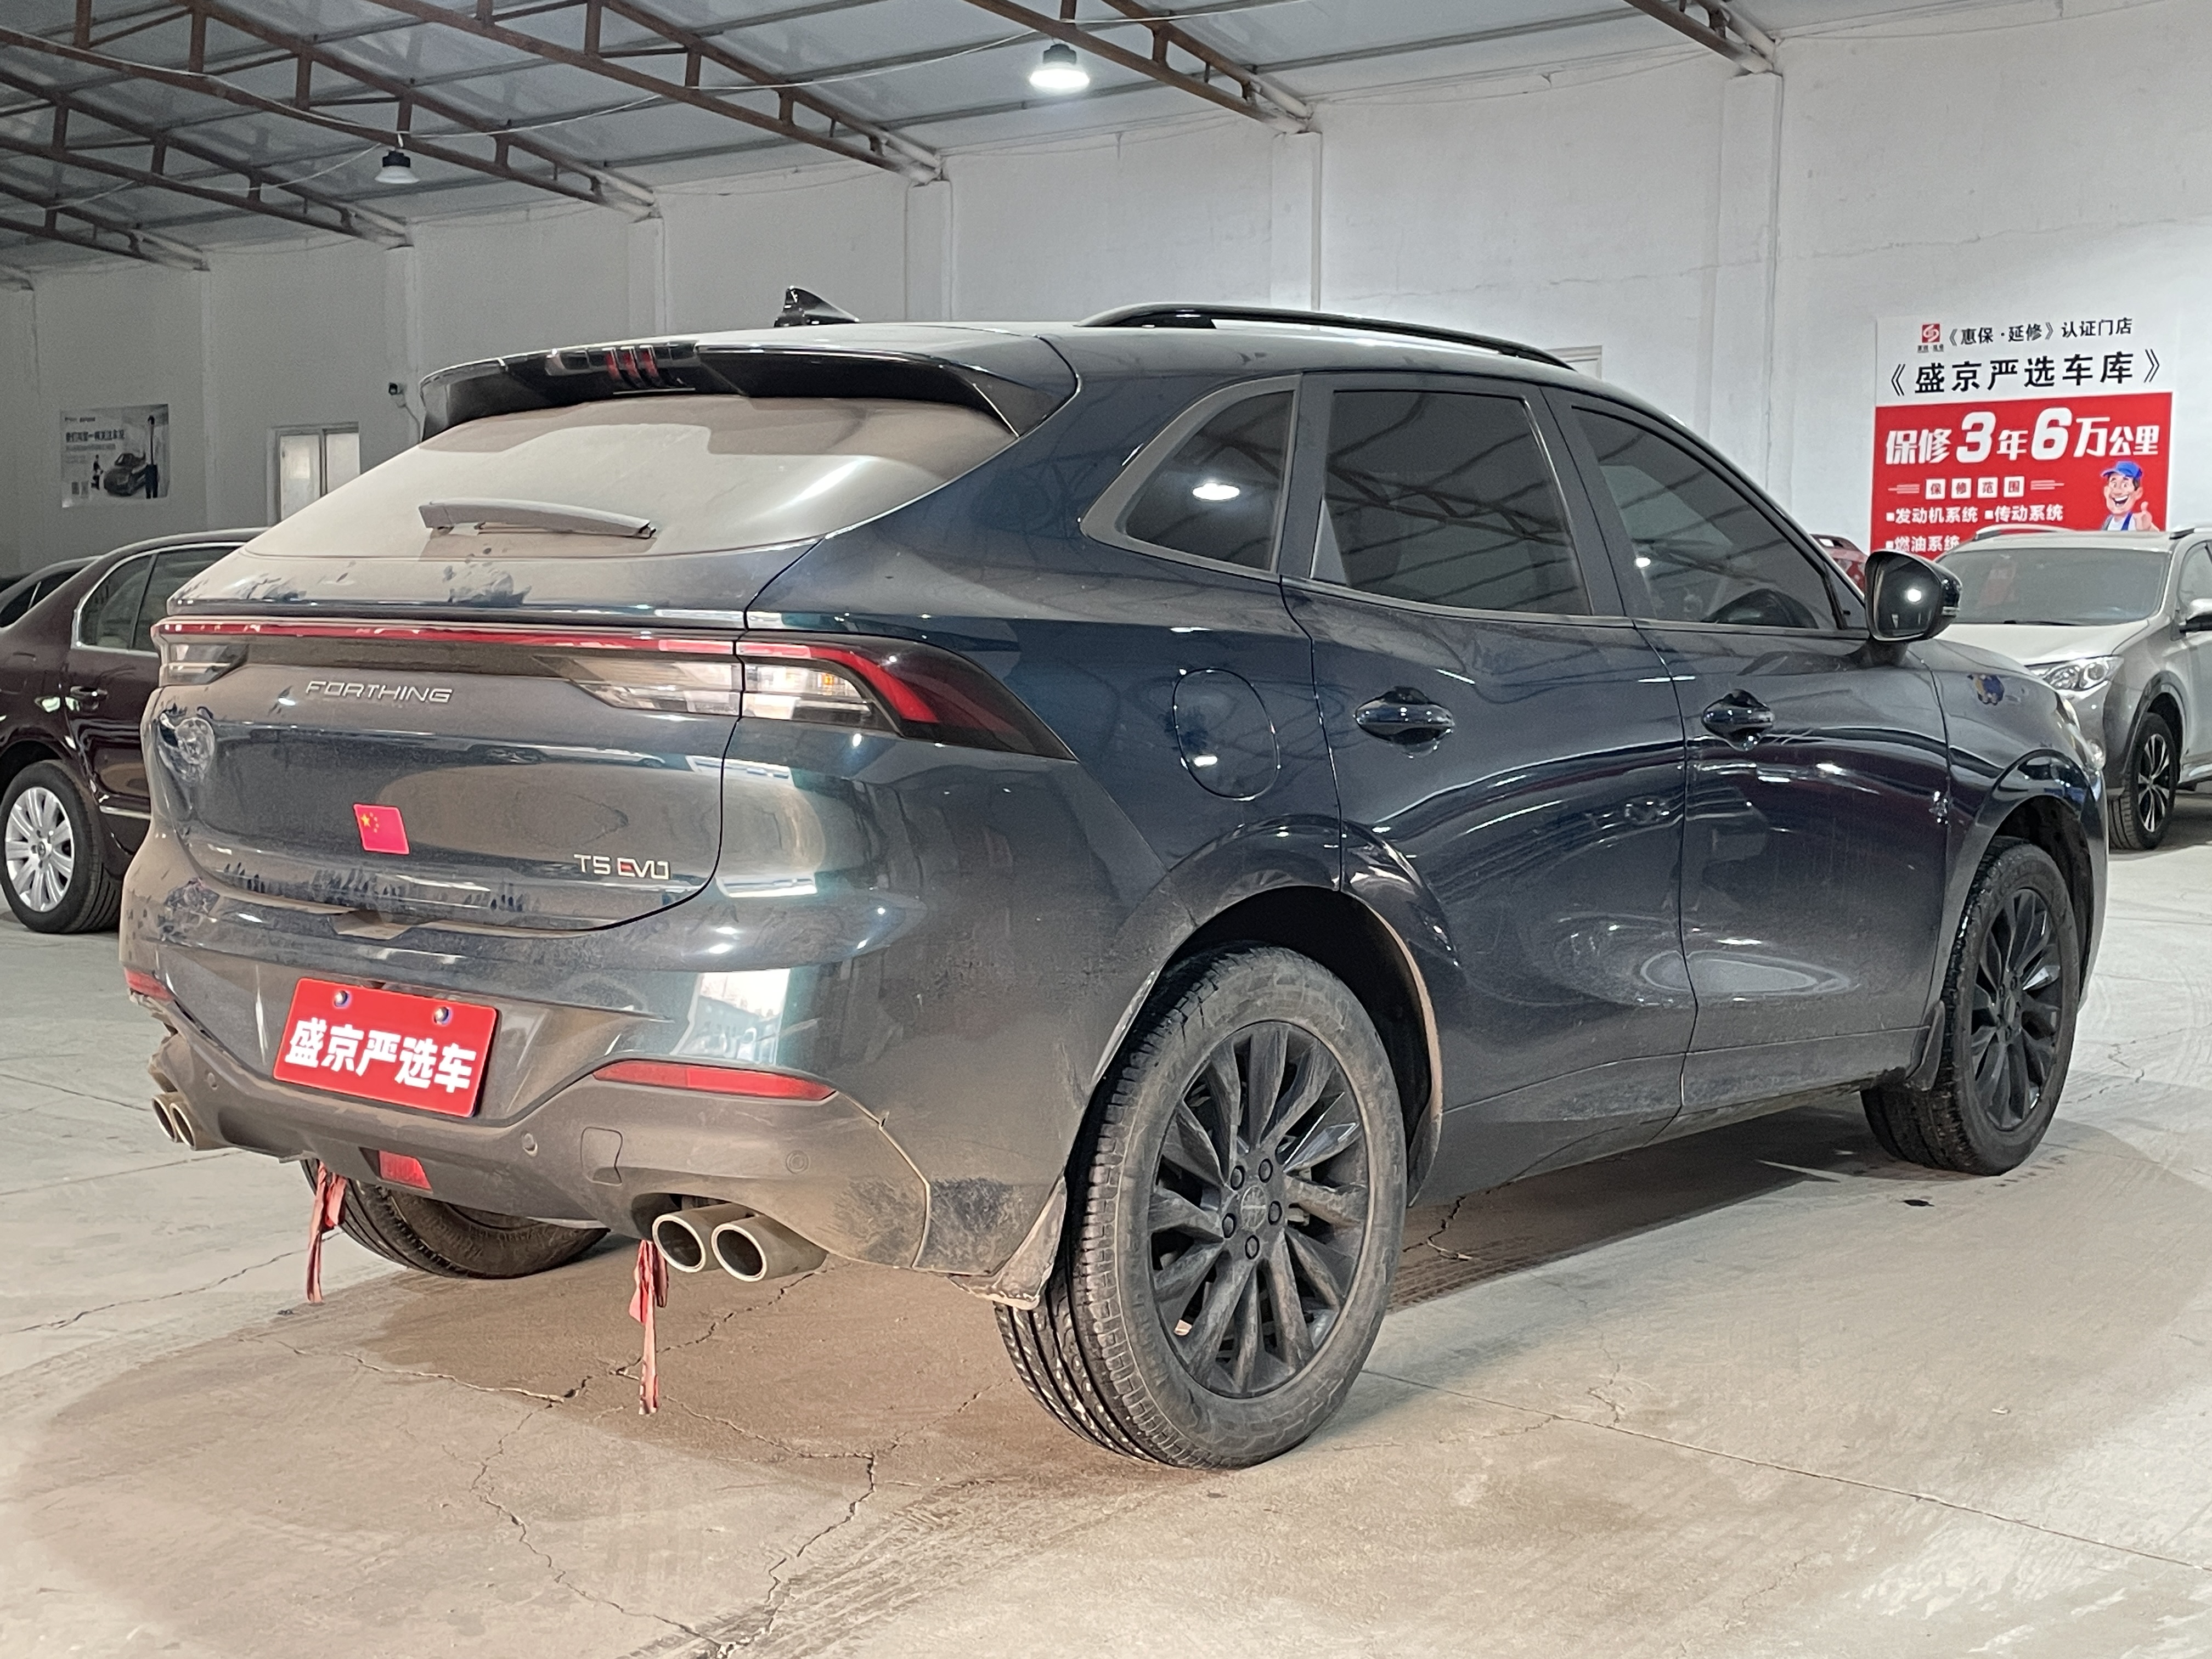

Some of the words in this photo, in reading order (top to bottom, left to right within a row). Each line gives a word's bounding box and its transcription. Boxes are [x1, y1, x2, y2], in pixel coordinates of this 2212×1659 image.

[1891, 348, 2160, 396] 《盛京严选车库》
[1886, 407, 2159, 465] 保修3年6万公里
[1895, 506, 1979, 524] 发动机系统
[1994, 504, 2064, 522] 传动系统
[306, 680, 453, 703] FORTHING
[617, 857, 669, 880] EVO
[284, 1017, 477, 1093] 盛京严选车
